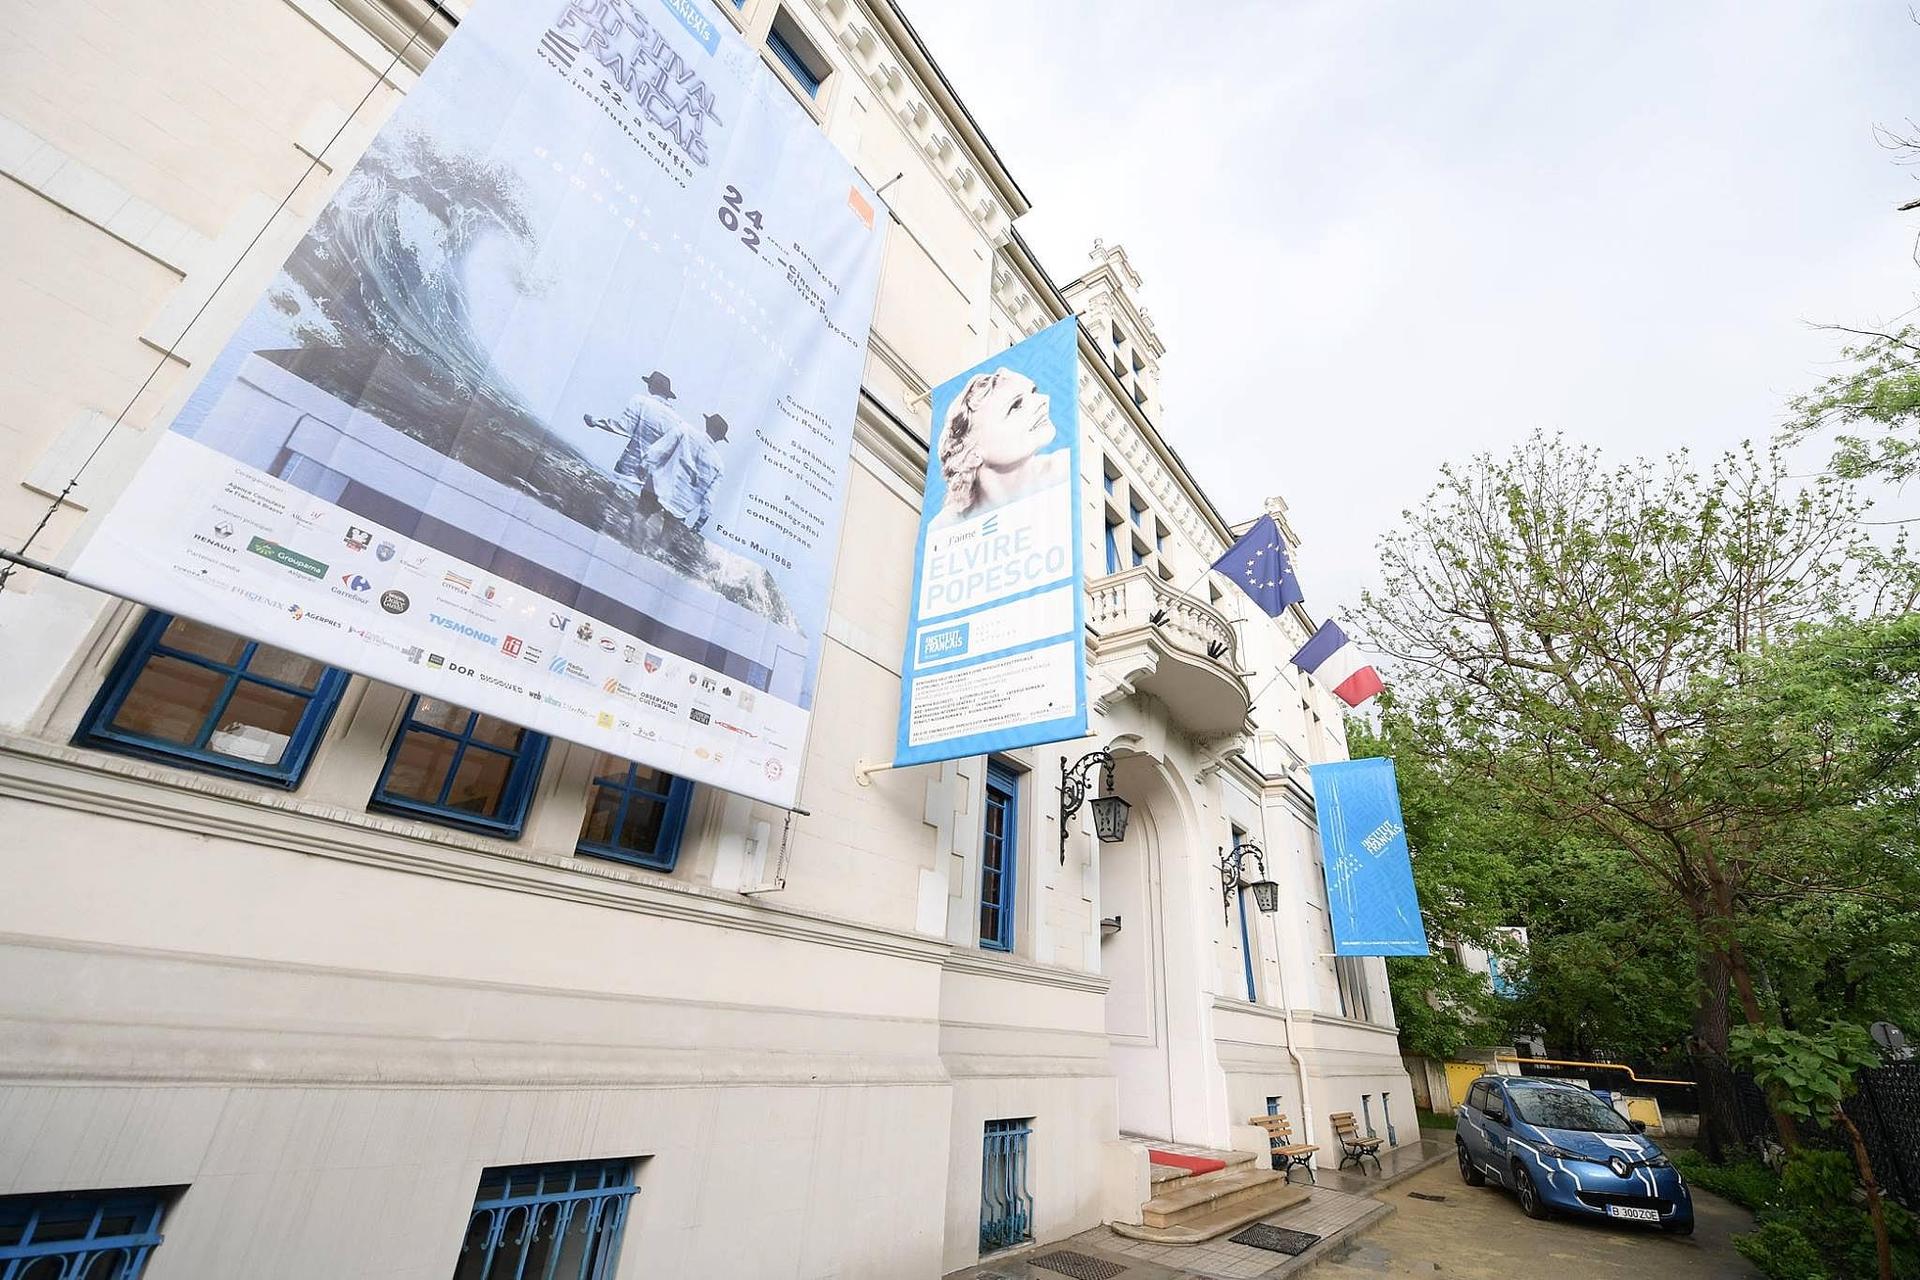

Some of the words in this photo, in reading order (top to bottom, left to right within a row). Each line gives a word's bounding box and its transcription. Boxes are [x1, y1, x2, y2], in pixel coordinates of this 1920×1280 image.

[556, 6, 709, 168] FRANÇAIS
[631, 44, 705, 136] FILM
[536, 46, 686, 189] www.institutfrancais.ro
[723, 185, 763, 231] 24
[718, 206, 760, 254] 02
[819, 306, 859, 348] Popesco
[790, 453, 801, 464] du
[784, 494, 825, 526] Panorama
[193, 533, 237, 554] RENAULT
[716, 524, 747, 545] Focus
[750, 540, 768, 557] Mai
[746, 508, 812, 549] contemporane
[276, 551, 321, 574] Groupama
[929, 526, 1033, 581] ELVIRE
[926, 546, 1065, 609] POPESCO
[331, 585, 369, 606] Carrefour
[304, 611, 342, 629] AGERPRES
[429, 613, 498, 645] TV5MONDE
[449, 663, 475, 677] DOR
[639, 691, 678, 709] OBSERVATOR
[639, 696, 671, 712] CULTURAL
[1612, 1206, 1621, 1217] B
